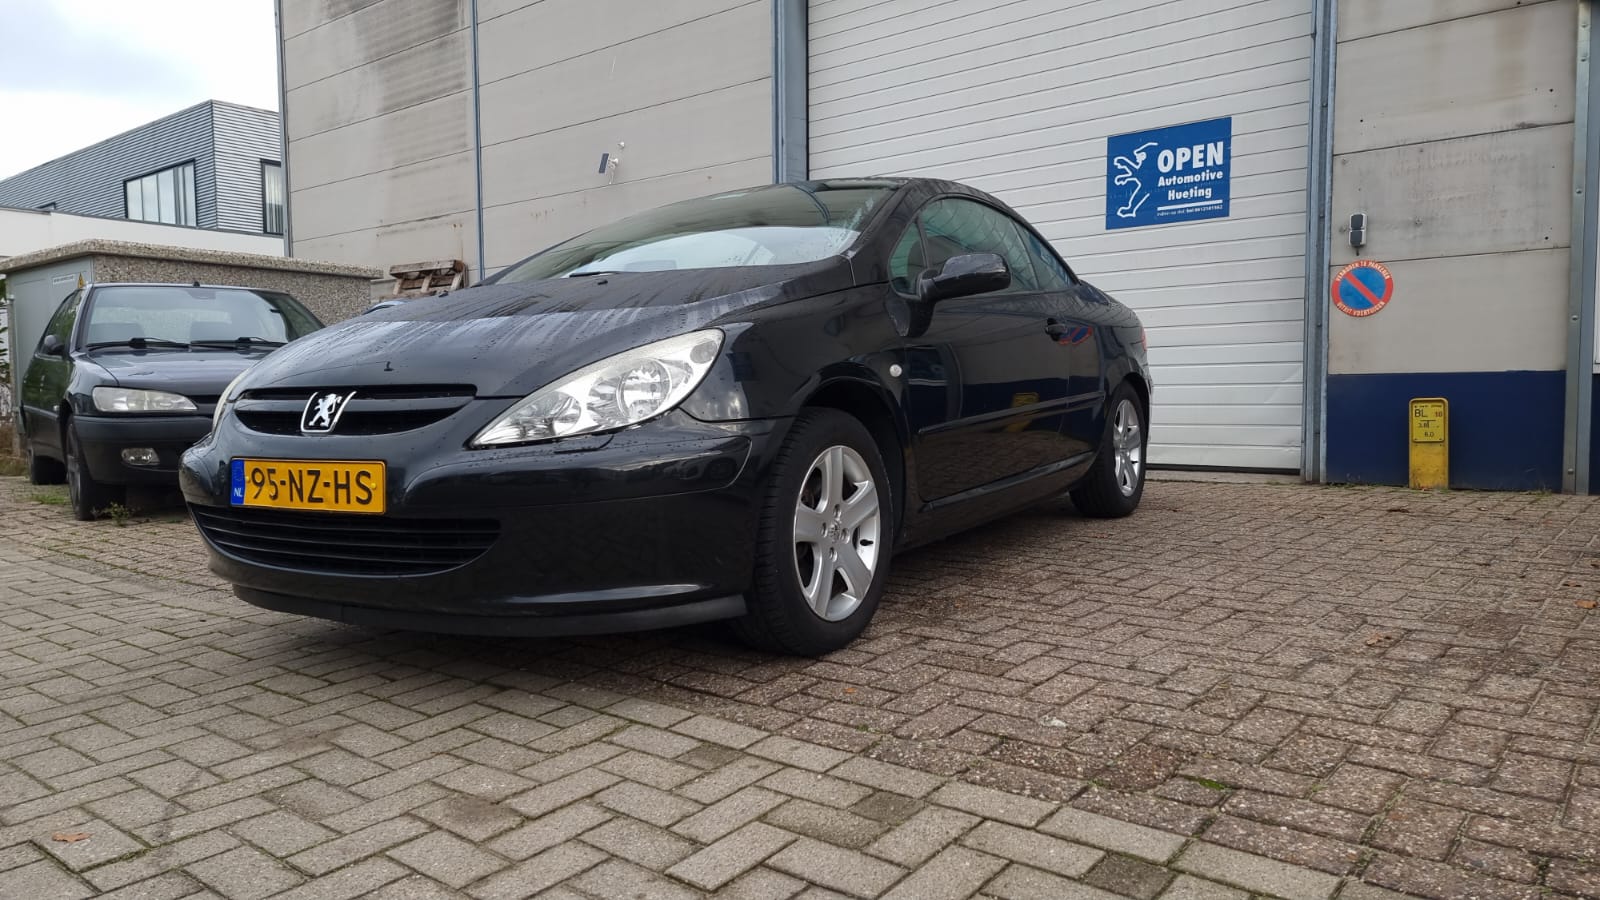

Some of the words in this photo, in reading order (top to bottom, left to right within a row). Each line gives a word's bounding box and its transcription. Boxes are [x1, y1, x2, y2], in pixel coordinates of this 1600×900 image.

[1157, 141, 1224, 173] OPEN
[1157, 169, 1223, 187] Automotive
[1168, 186, 1212, 201] Hueting
[233, 488, 243, 498] NL
[251, 467, 373, 505] 95-NZ-HS
